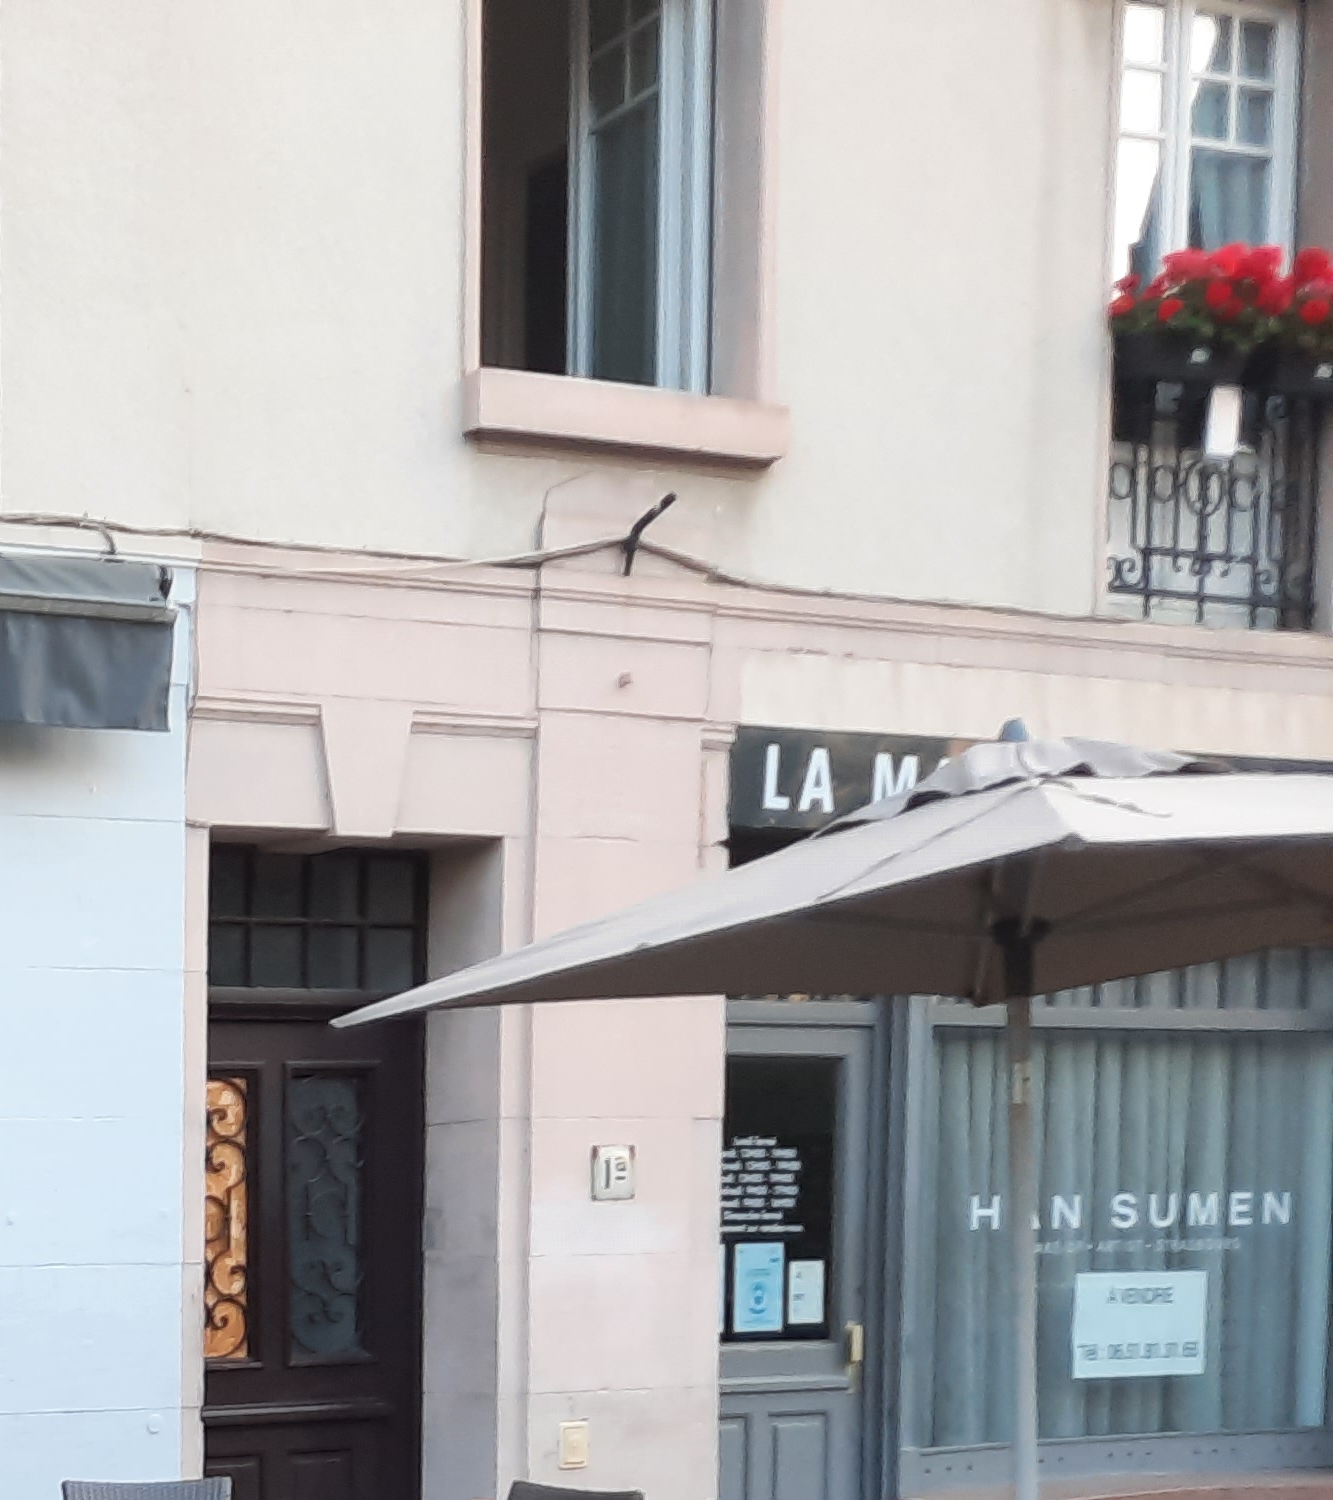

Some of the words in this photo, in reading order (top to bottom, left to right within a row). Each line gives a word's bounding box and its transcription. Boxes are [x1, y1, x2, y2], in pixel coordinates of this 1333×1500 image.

[762, 743, 834, 814] LA
[969, 1193, 1082, 1231] HN
[1111, 1190, 1292, 1230] SUMEN
